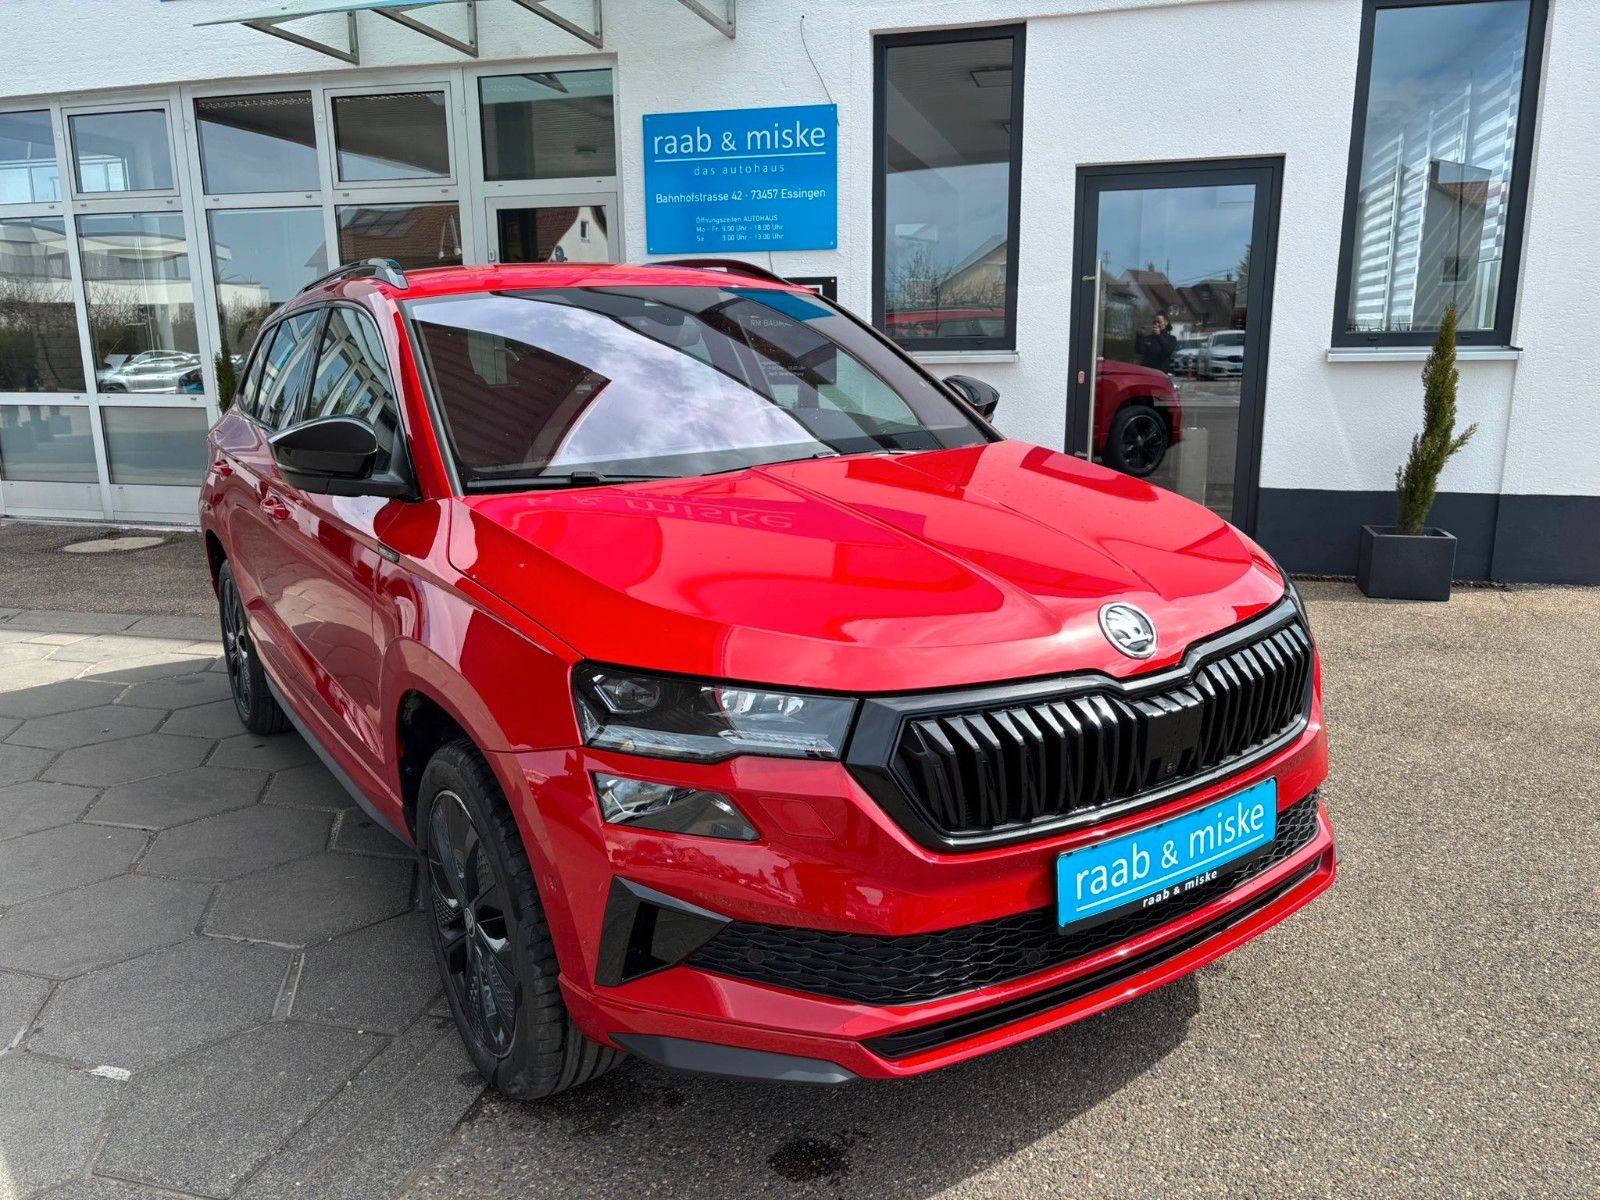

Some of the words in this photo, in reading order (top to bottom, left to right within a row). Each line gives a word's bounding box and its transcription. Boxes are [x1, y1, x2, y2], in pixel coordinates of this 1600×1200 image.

[654, 126, 712, 155] raab
[721, 131, 737, 151] &
[747, 120, 826, 150] miske
[694, 165, 716, 176] das
[722, 164, 785, 175] autohaus
[656, 192, 729, 204] Bahnhofstrasse
[731, 190, 743, 201] 42
[751, 188, 779, 200] 73457
[781, 187, 826, 201] Essingen
[743, 214, 778, 222] AUTOHAUS
[736, 224, 747, 232] Uhr
[772, 223, 784, 231] Uhr
[736, 233, 747, 241] Uhr
[772, 232, 784, 240] Uhr
[1076, 842, 1151, 900] raab
[1160, 840, 1179, 869] &
[1189, 801, 1265, 859] miske
[1142, 889, 1170, 908] raab
[1173, 886, 1181, 896] &
[1184, 869, 1218, 891] miske
